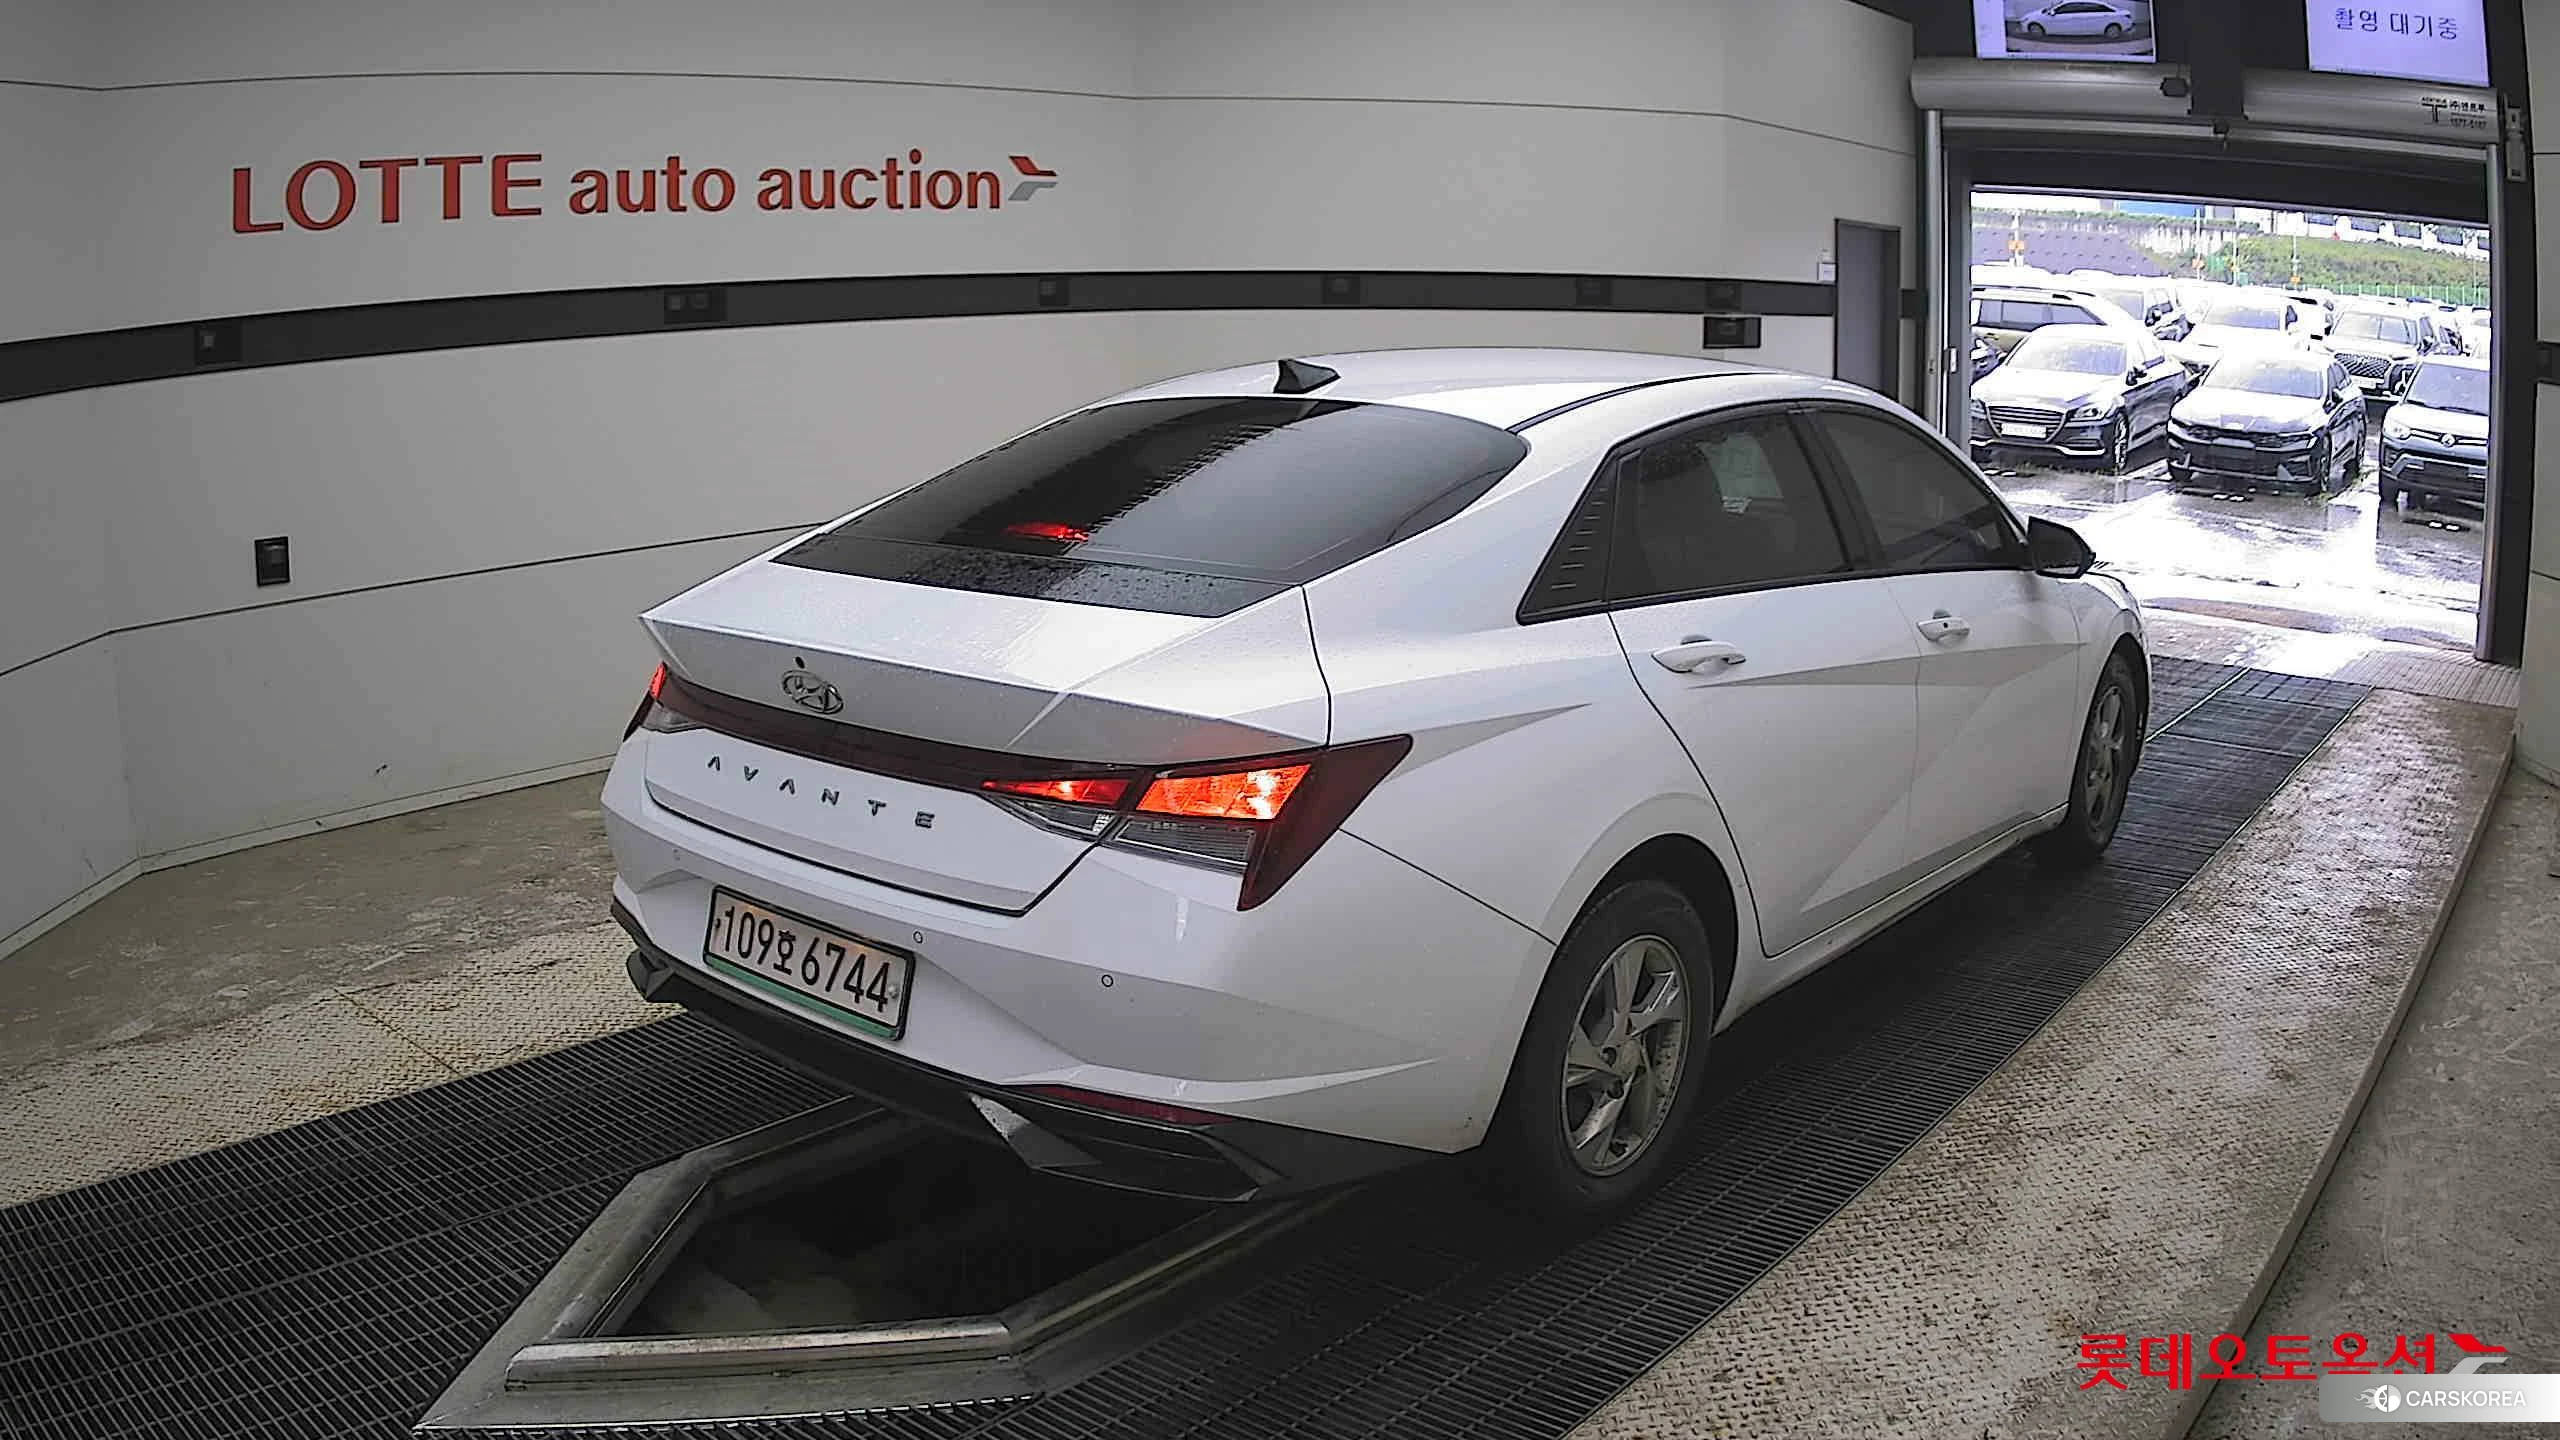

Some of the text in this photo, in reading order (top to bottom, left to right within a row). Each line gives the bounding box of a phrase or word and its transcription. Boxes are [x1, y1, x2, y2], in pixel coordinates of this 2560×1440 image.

[2334, 8, 2458, 41] 촬영 대기중
[233, 149, 1003, 234] LOTTE auto auction
[706, 755, 936, 830] AVANTE
[723, 904, 892, 1014] 109호6744
